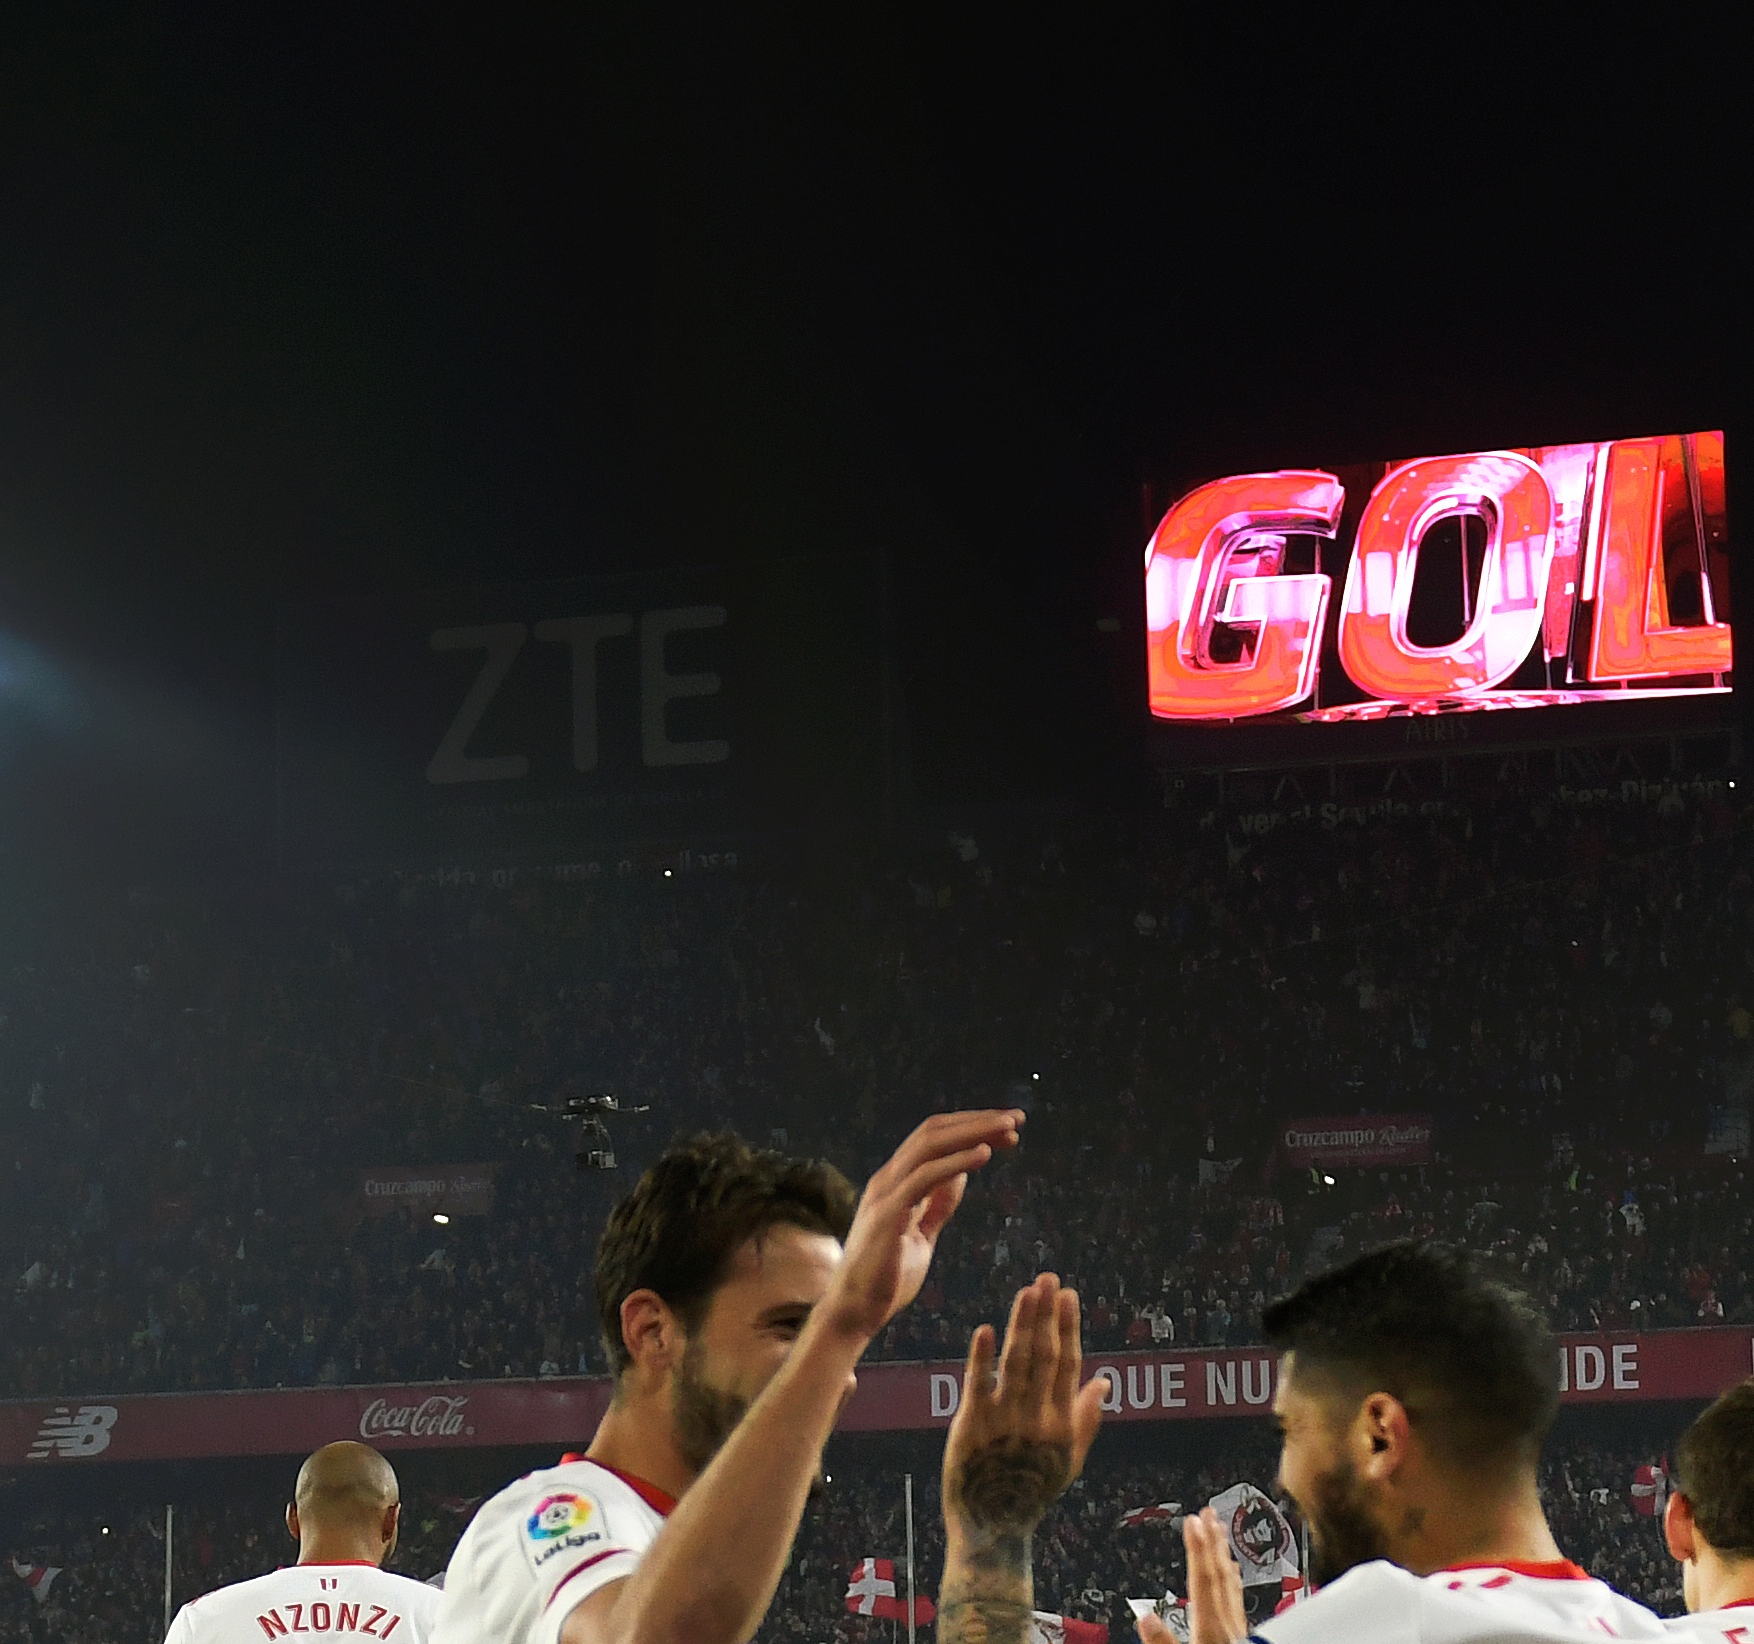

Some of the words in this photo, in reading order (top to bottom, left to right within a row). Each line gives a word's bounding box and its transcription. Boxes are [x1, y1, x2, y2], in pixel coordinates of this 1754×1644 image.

[1145, 441, 1732, 720] GOL
[426, 604, 730, 785] ZTE
[1284, 1128, 1375, 1147] Cruzcampo
[1095, 1364, 1187, 1414] QUE
[359, 1395, 470, 1439] Coca-Cola
[533, 1530, 601, 1567] LaLiga
[256, 1602, 401, 1641] NZONZI
